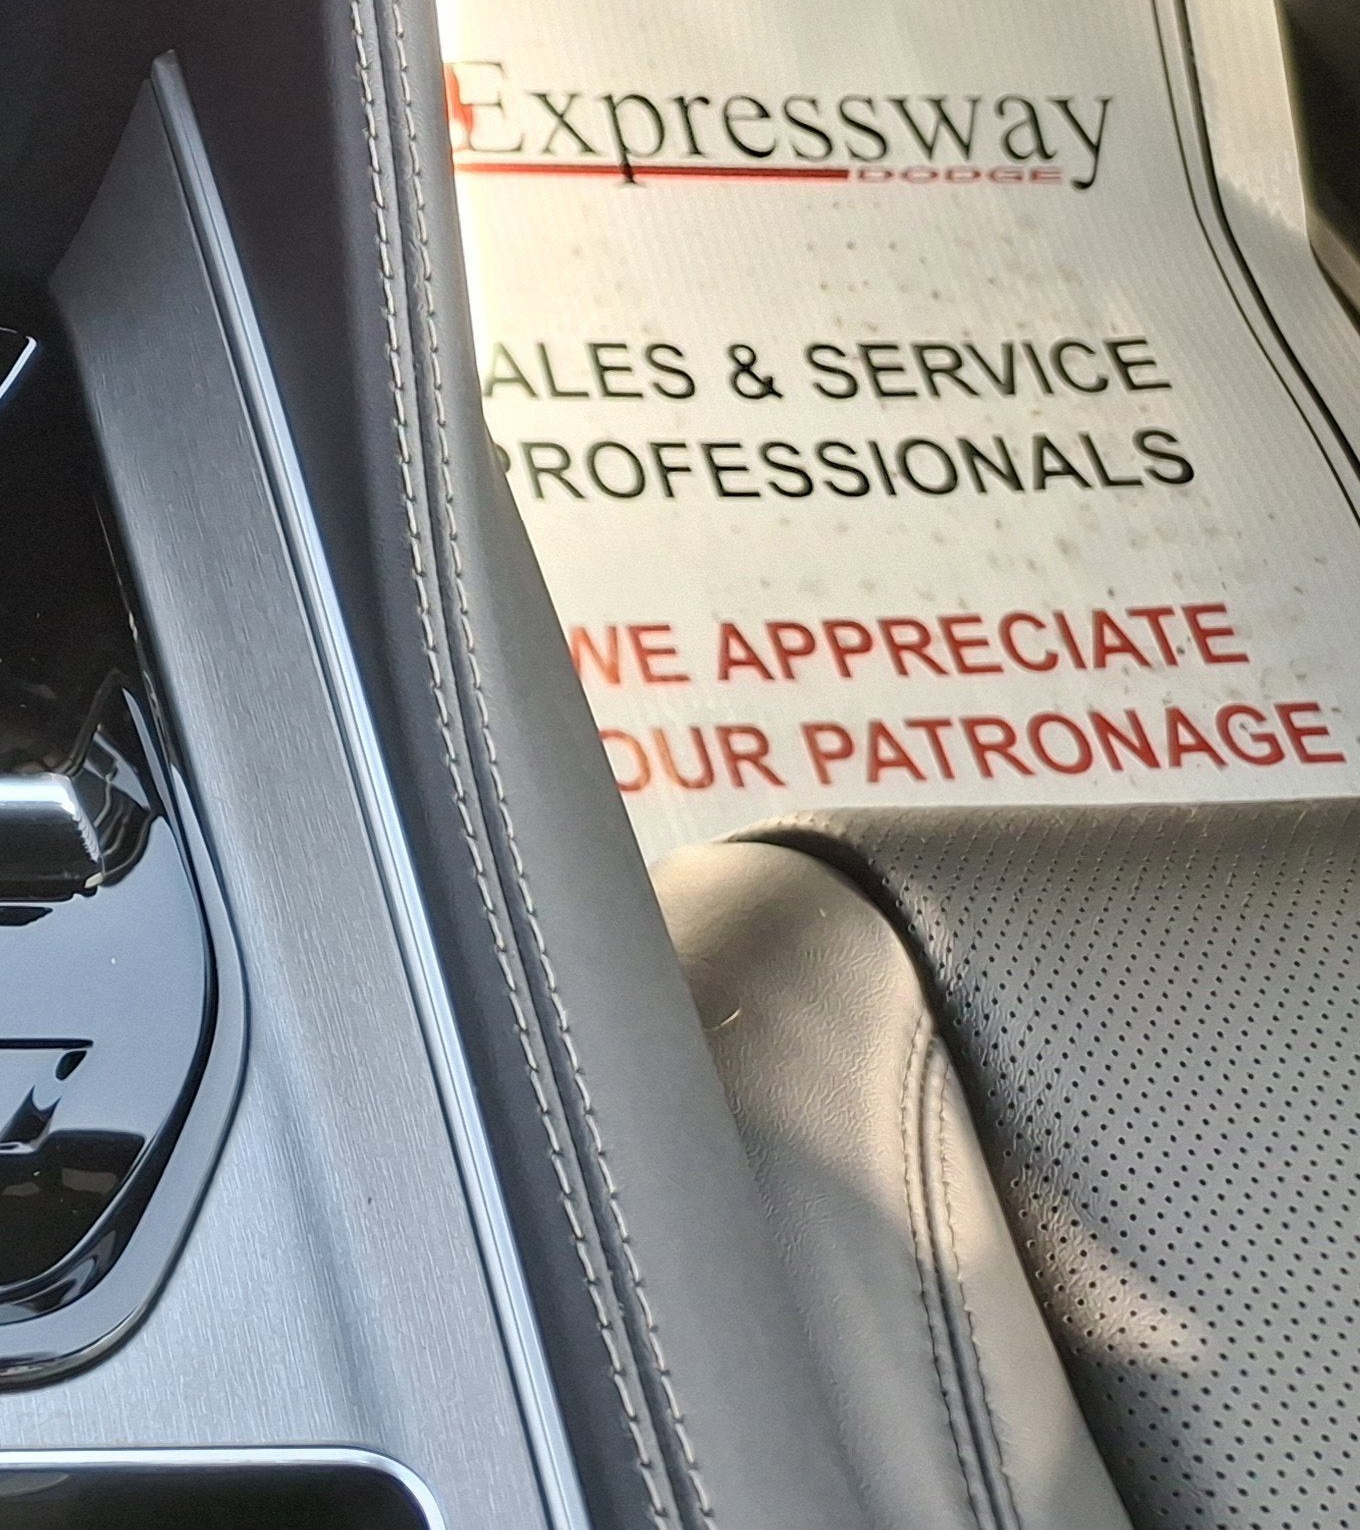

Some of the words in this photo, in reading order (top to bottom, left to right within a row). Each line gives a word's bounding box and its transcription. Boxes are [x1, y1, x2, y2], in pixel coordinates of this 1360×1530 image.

[445, 60, 1113, 189] Expressway
[857, 166, 1063, 183] DODGE
[483, 342, 696, 400] ALES
[726, 343, 784, 399] &
[807, 336, 1173, 400] SERVICE
[715, 603, 1250, 683] APPRECIATE
[600, 722, 786, 793] OUR
[803, 701, 1346, 786] PATRONAGE
